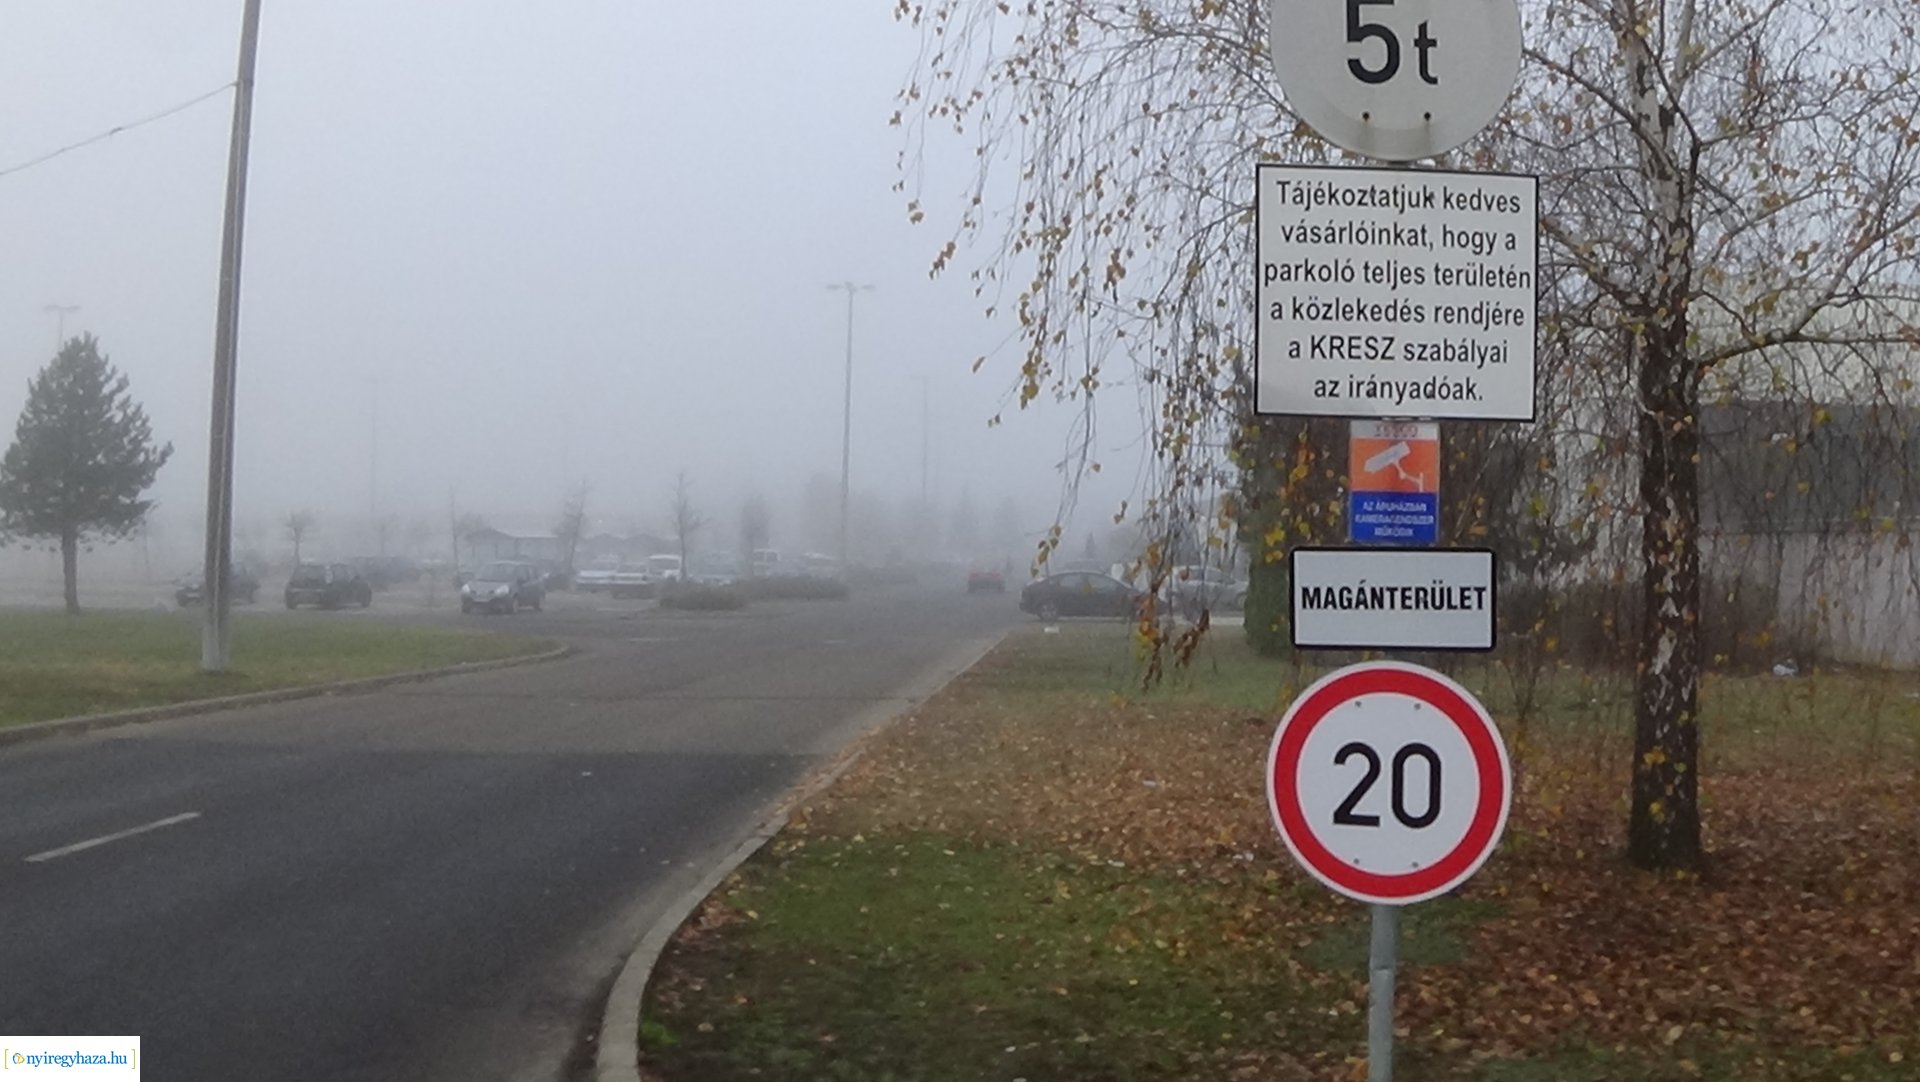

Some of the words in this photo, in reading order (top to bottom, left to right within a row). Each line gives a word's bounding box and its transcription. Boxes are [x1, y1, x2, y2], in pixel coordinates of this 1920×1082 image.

[1346, 0, 1400, 84] 5
[1413, 21, 1438, 85] t
[1276, 180, 1435, 214] Tájékoztatjuk
[1443, 185, 1520, 214] kedves
[1281, 222, 1434, 251] vásárlóinkat,
[1442, 224, 1497, 255] hogy
[1505, 232, 1516, 251] a
[1264, 259, 1355, 288] parkoló
[1363, 261, 1425, 290] teljes
[1434, 263, 1530, 289] területén
[1270, 302, 1283, 320] a
[1292, 296, 1425, 324] közlekedés
[1434, 301, 1524, 331] rendjére
[1288, 341, 1301, 358] a
[1310, 336, 1395, 360] KRESZ
[1403, 339, 1509, 365] szabályai
[1314, 379, 1340, 397] az
[1348, 376, 1483, 404] irányadóak.
[1302, 580, 1487, 612] MAGÁNTERÜLET
[1333, 742, 1442, 829] 20
